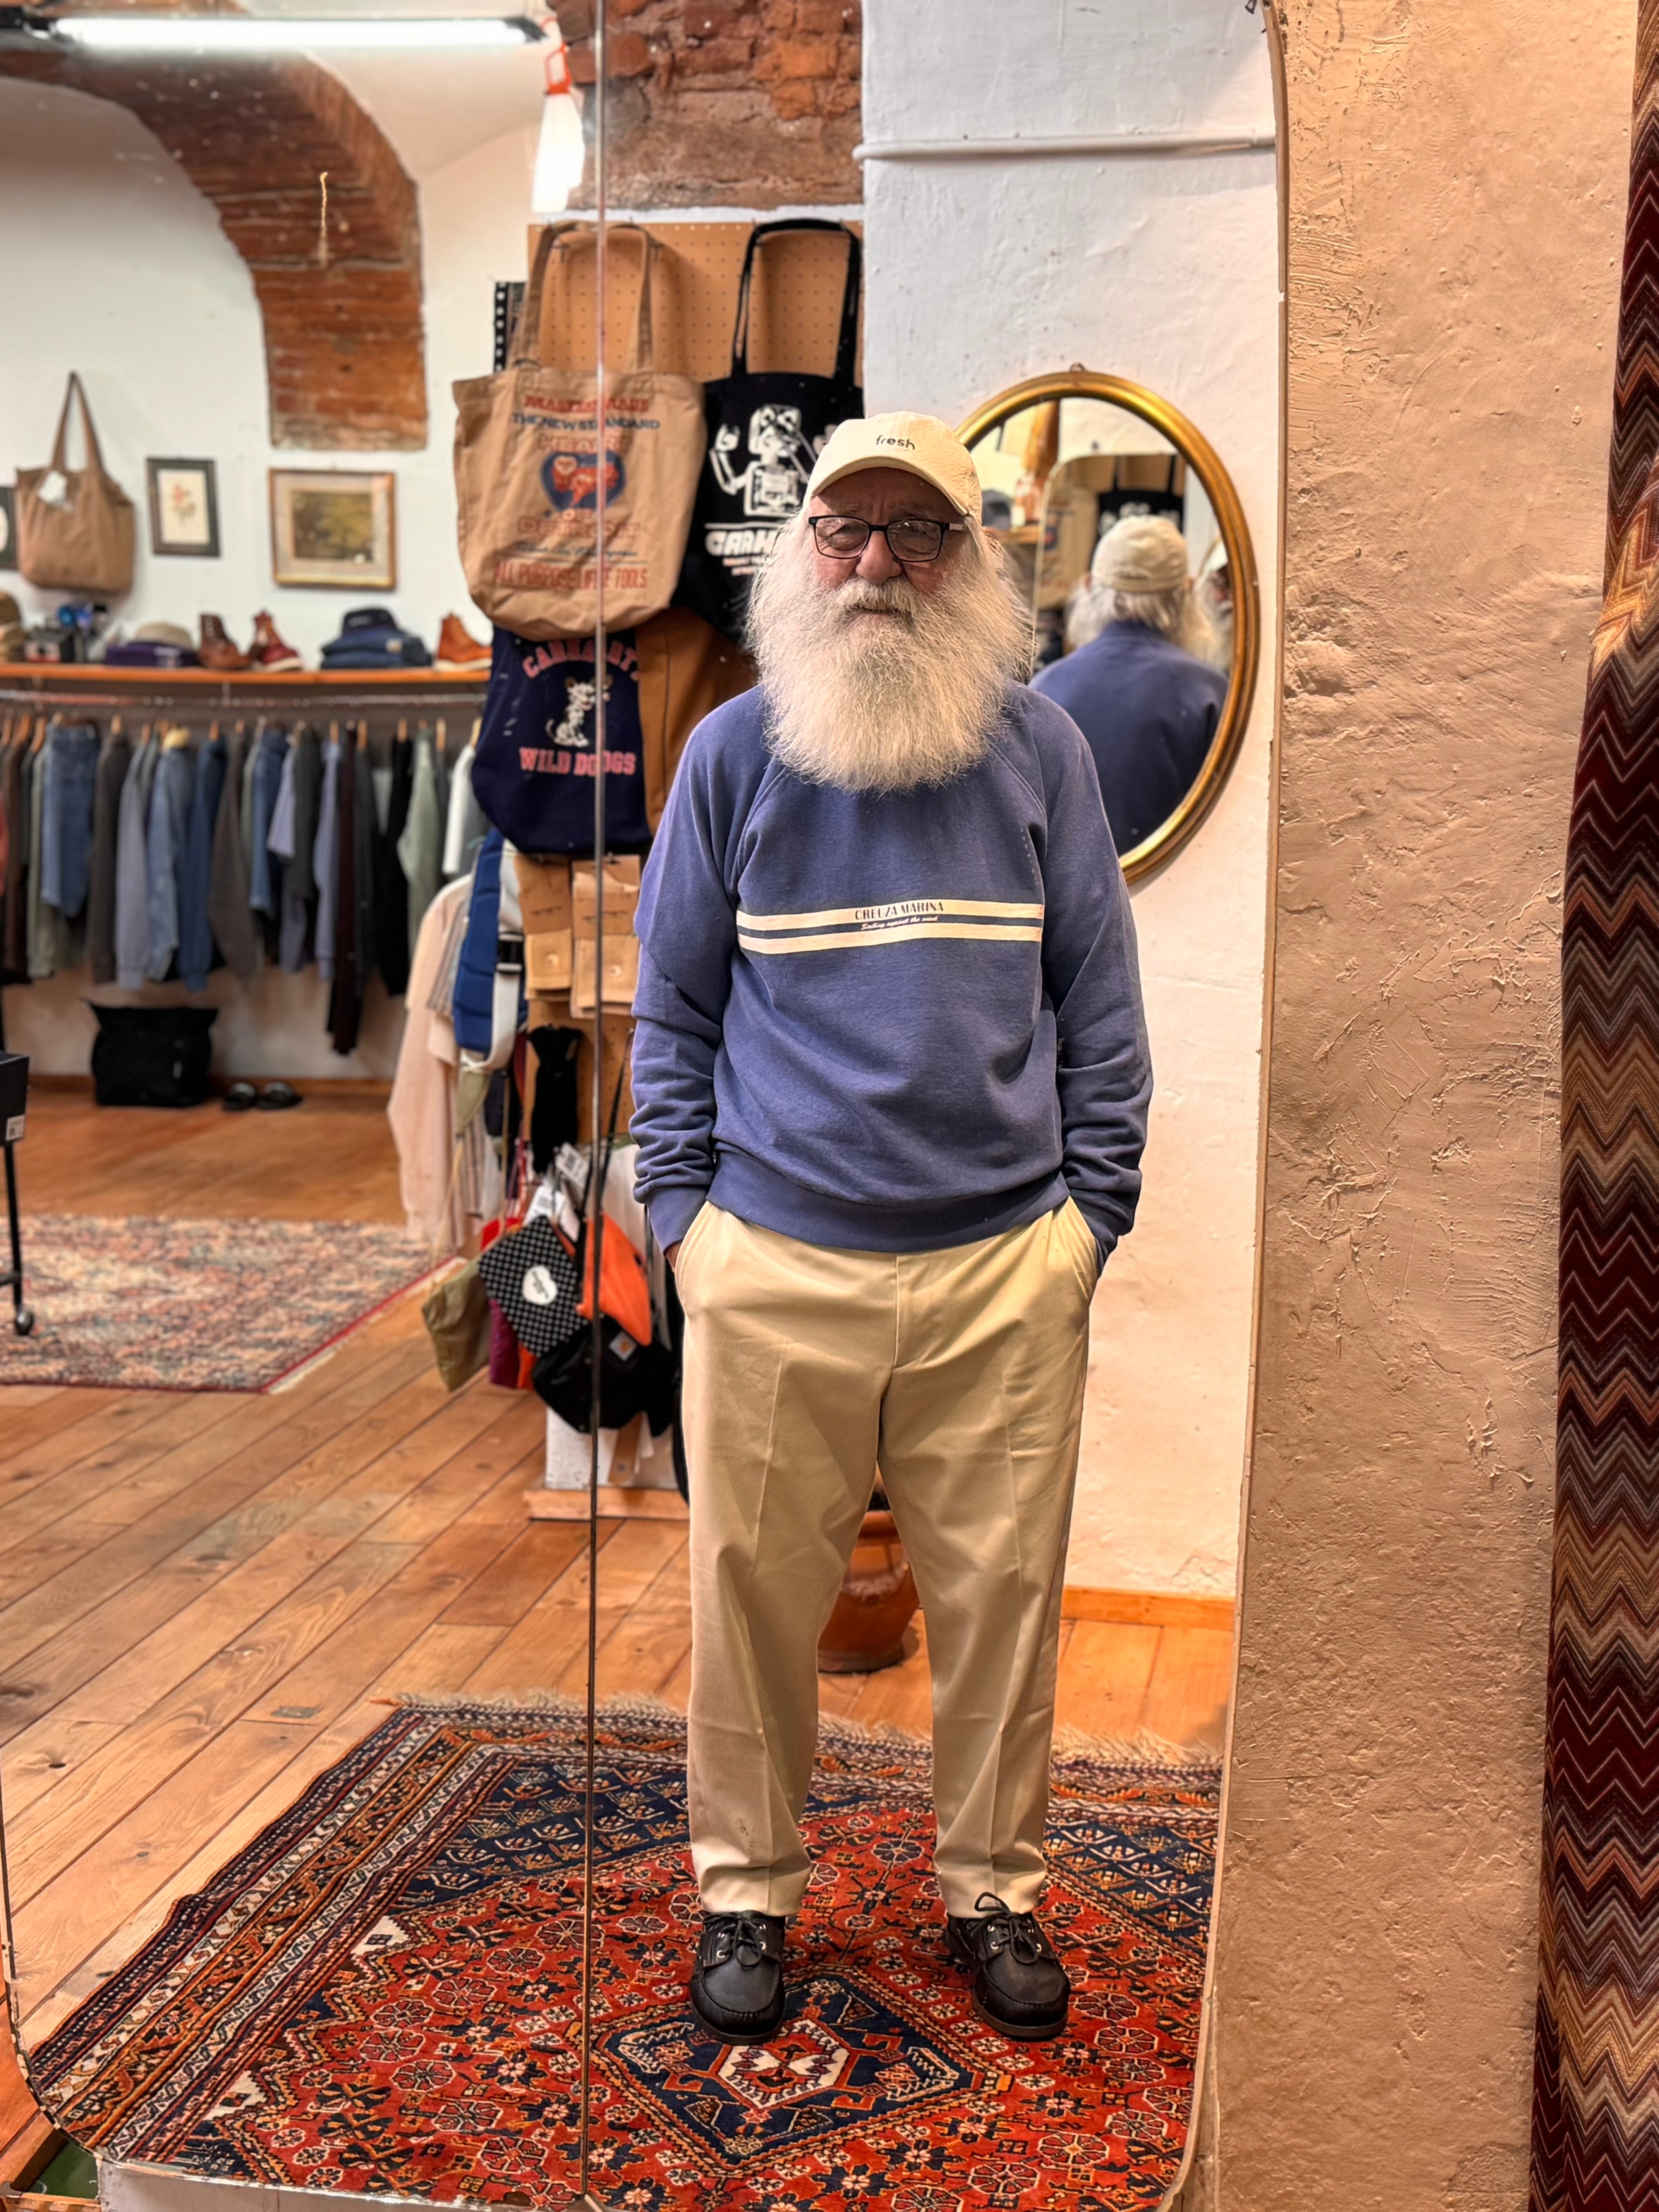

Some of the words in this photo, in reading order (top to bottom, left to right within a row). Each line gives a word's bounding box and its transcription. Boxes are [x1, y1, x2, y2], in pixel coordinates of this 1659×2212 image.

[876, 434, 915, 450] fresh
[615, 566, 648, 589] TOOLS
[519, 747, 572, 774] WILD
[855, 905, 897, 920] CREUZA
[900, 902, 943, 914] MARINA
